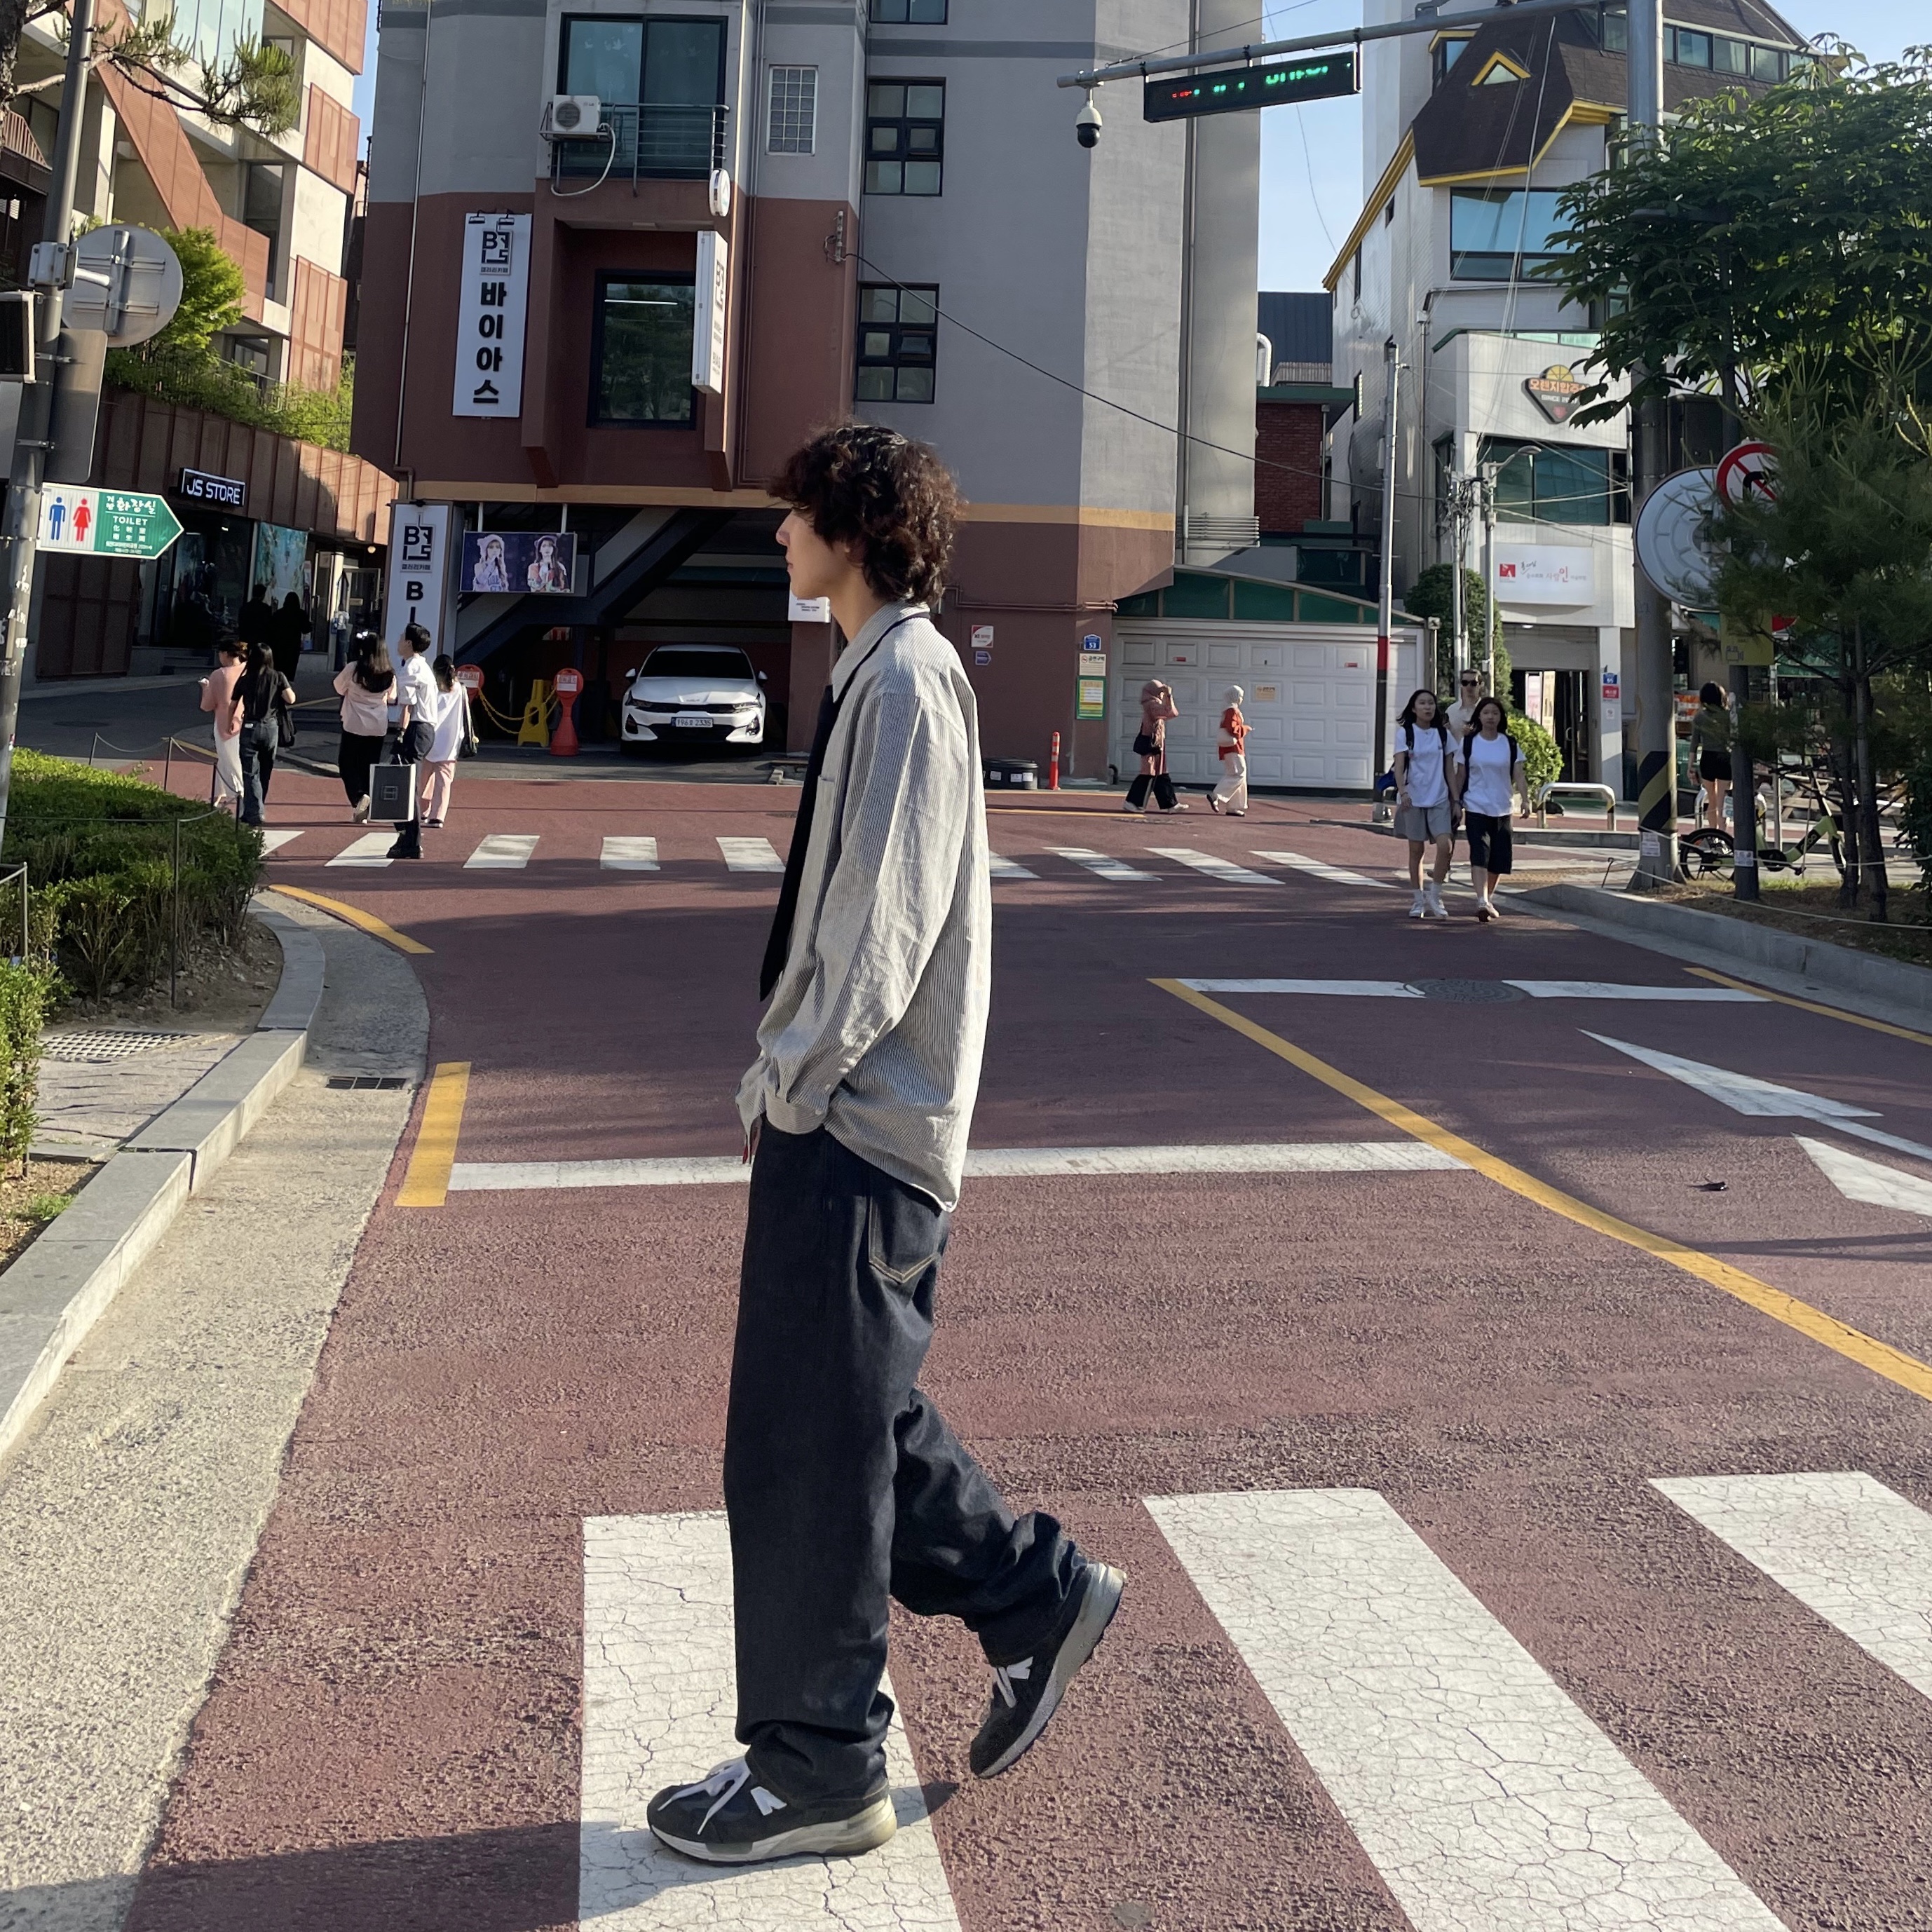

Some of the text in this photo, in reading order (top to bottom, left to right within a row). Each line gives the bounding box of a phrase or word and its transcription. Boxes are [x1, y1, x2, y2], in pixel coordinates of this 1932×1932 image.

[473, 282, 507, 404] 바이아스
[186, 478, 241, 505] JS STORE
[116, 496, 156, 515] 화장실
[113, 515, 148, 526] TOILET
